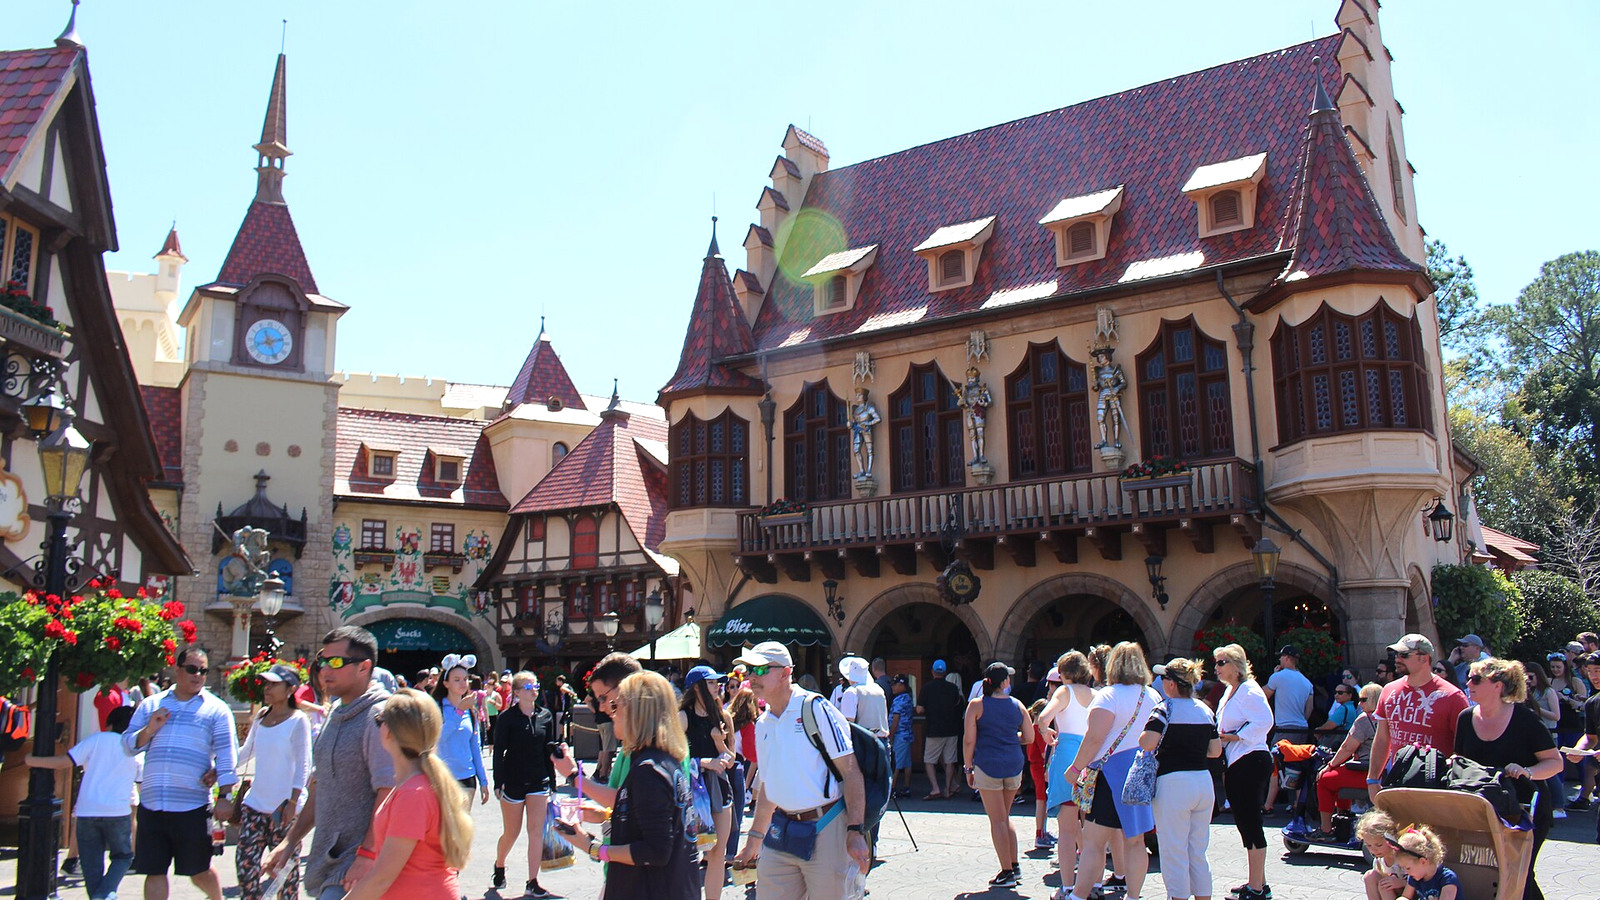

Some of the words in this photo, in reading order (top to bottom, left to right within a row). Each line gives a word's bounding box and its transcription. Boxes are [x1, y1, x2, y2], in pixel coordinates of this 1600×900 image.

[395, 627, 422, 639] Snacks
[724, 618, 752, 634] Bier
[1384, 690, 1414, 706] AM.
[1385, 704, 1434, 727] EAGLE
